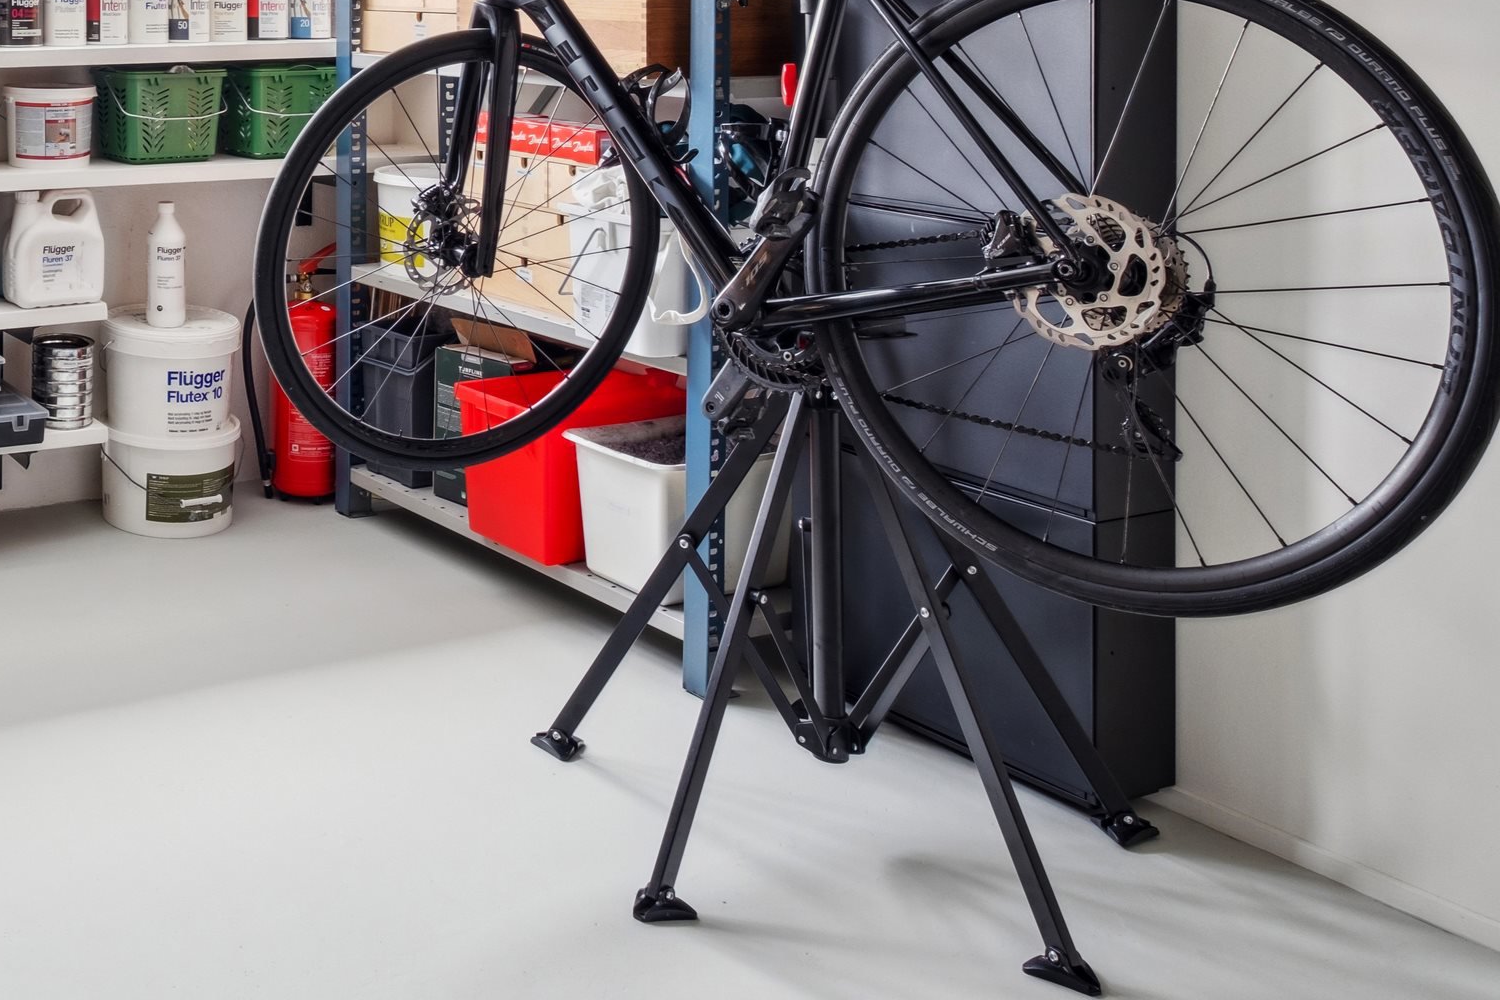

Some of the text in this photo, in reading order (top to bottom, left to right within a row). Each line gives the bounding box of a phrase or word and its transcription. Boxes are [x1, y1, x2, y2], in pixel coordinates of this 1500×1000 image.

[213, 1, 243, 10] Flügger
[11, 8, 24, 18] 04
[177, 21, 188, 30] 50
[300, 19, 310, 28] 20
[1347, 43, 1411, 102] DURANO
[1409, 105, 1448, 151] PLUS
[381, 214, 394, 228] RUP
[42, 245, 75, 256] Flügger
[156, 246, 182, 256] Flügger
[42, 254, 73, 264] Fluren 37
[166, 369, 226, 389] Flügger
[166, 386, 223, 403] Flutex 10
[835, 376, 998, 552] SCHWALBE DURANO PLUS
